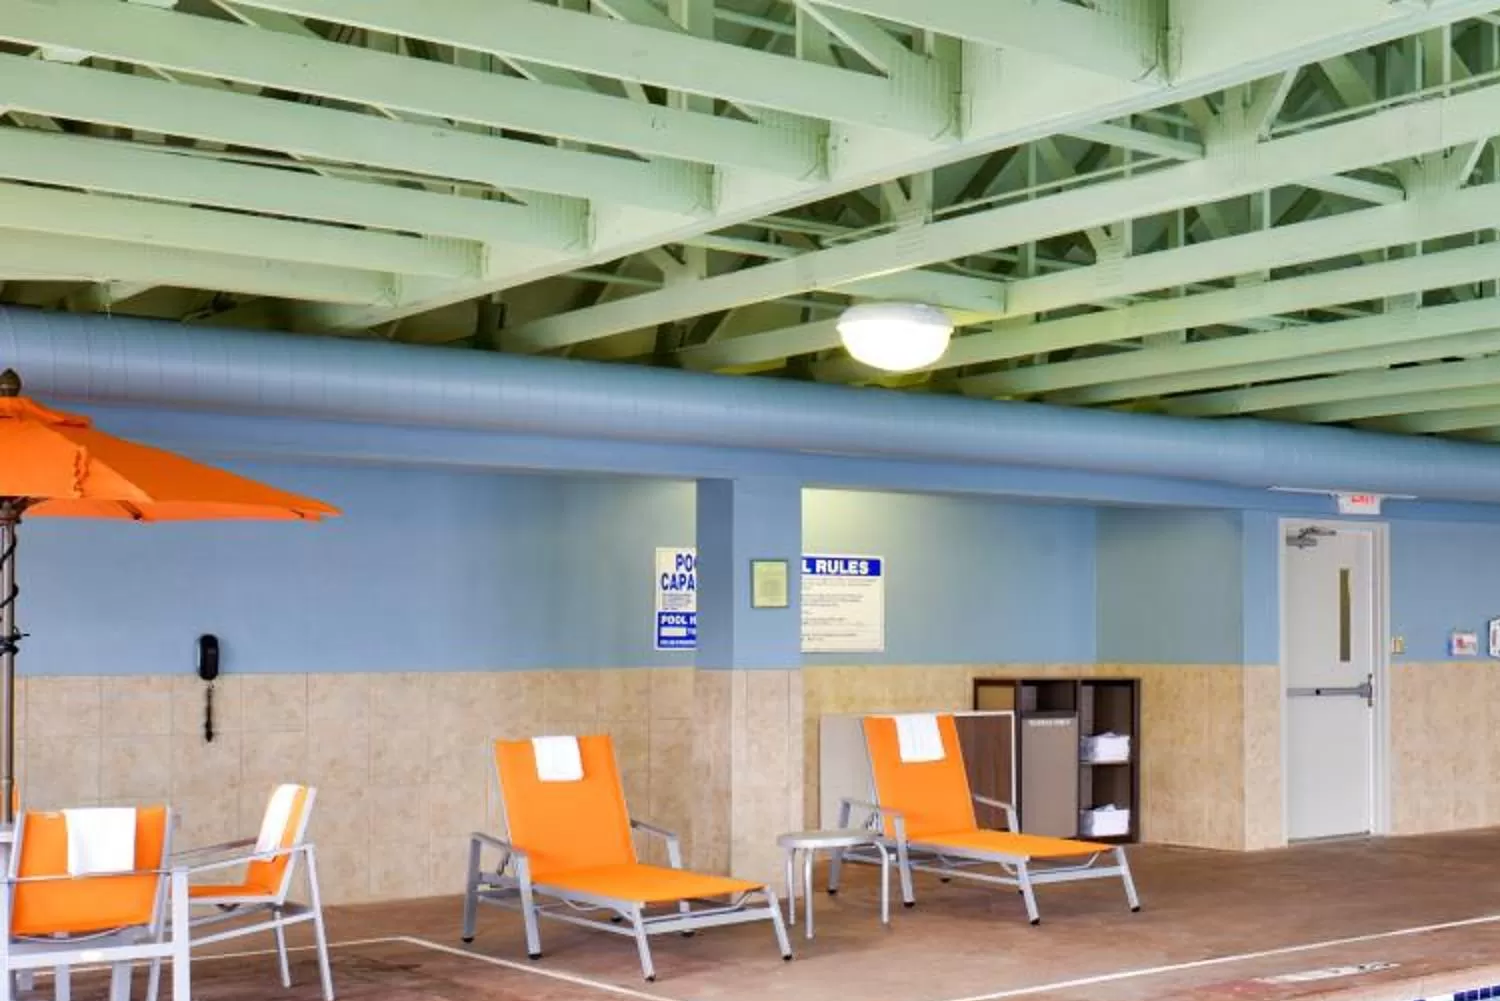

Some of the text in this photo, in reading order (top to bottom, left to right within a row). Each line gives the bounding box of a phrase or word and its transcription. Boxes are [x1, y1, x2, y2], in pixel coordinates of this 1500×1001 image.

[675, 553, 697, 573] PO
[814, 559, 869, 575] RULES
[661, 573, 695, 591] CAPA
